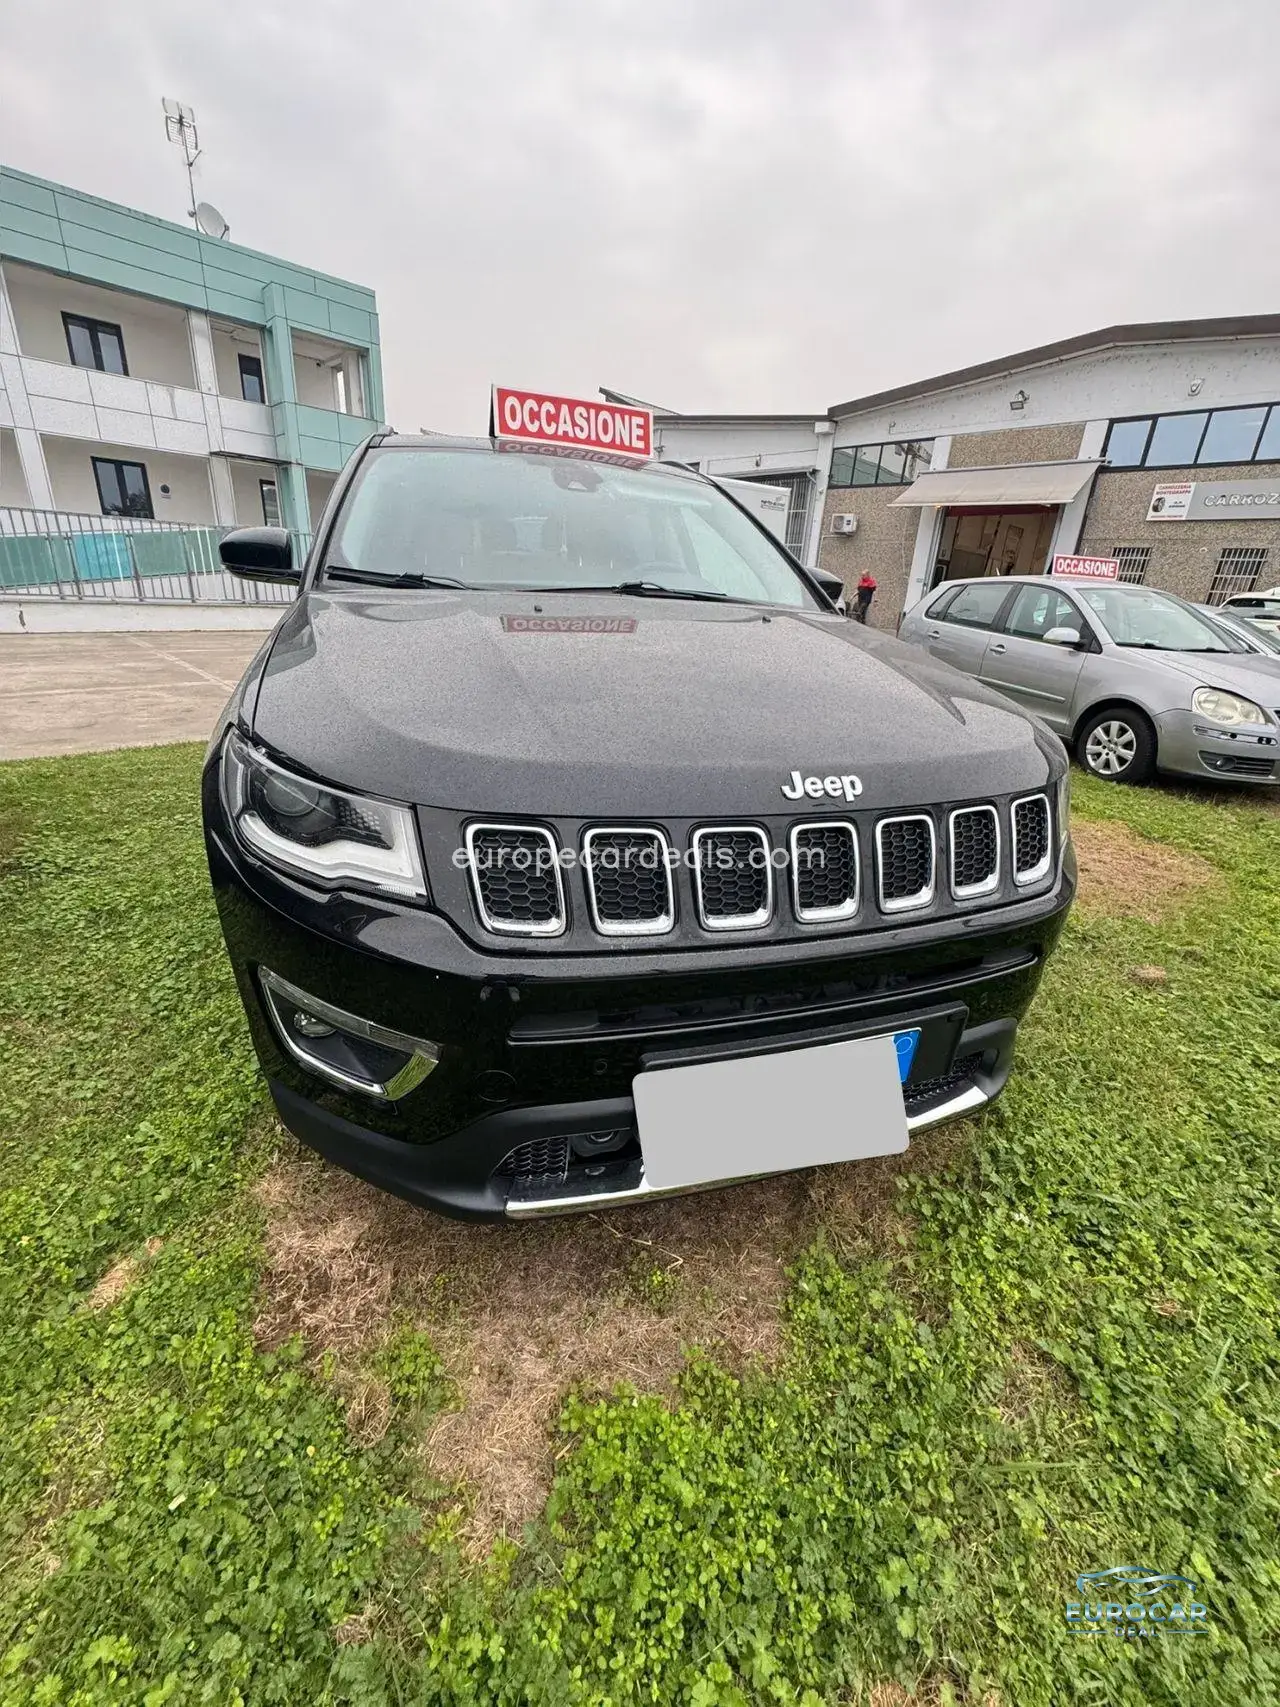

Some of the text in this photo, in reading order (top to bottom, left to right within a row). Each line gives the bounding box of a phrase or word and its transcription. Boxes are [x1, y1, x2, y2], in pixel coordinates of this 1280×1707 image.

[504, 395, 646, 449] OCCASIONE
[1056, 557, 1116, 577] OCCASIONE
[781, 770, 863, 802] Jeep
